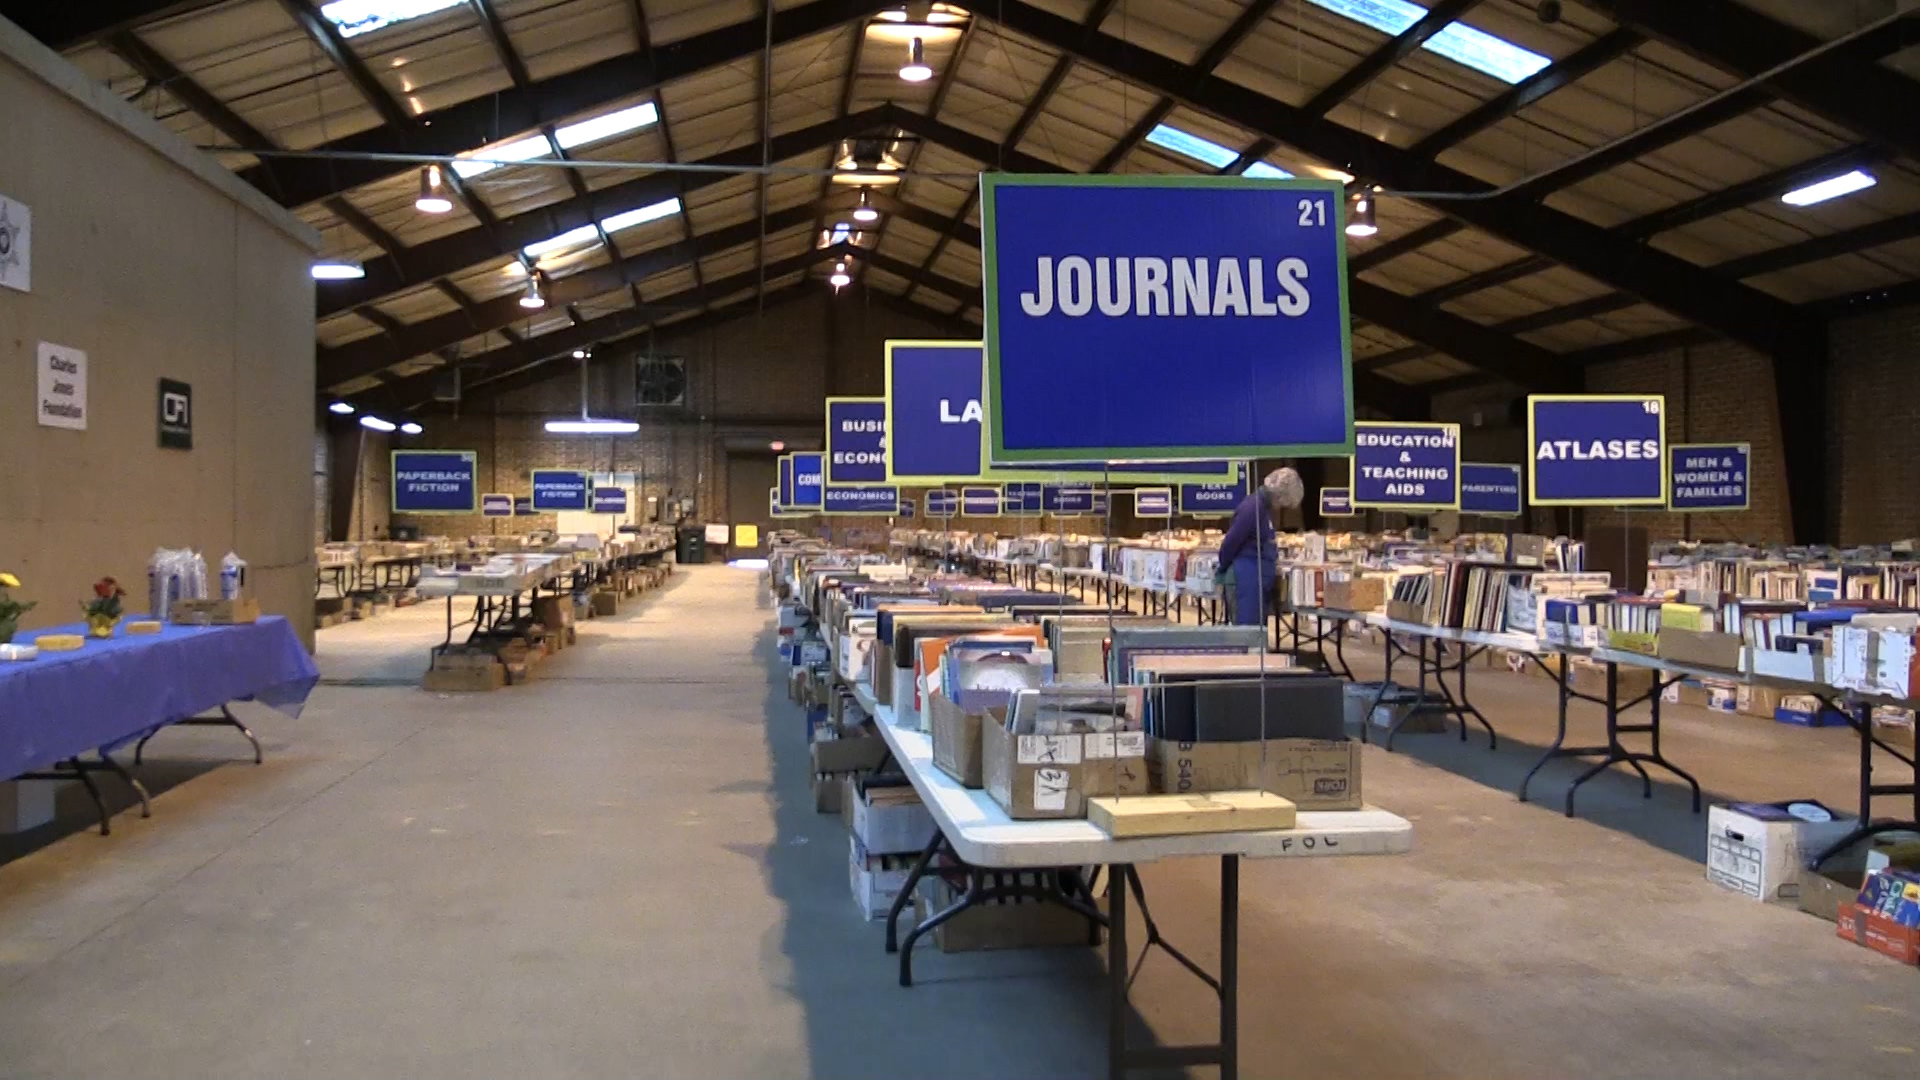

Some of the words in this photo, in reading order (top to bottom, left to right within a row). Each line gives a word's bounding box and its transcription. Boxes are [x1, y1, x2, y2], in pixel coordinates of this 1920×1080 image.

[1298, 199, 1326, 226] 21
[1020, 256, 1310, 316] JOURNALS
[940, 399, 983, 422] LA
[1642, 401, 1659, 414] 18
[842, 420, 886, 432] BUSI
[1357, 433, 1454, 448] EDUCATION
[1536, 440, 1659, 460] ATLASES
[834, 452, 886, 464] ECON
[1399, 451, 1411, 463] &
[1686, 457, 1717, 468] MEN
[1722, 456, 1732, 468] &
[397, 471, 471, 480] PAPERBACK
[798, 473, 821, 486] COM
[1362, 466, 1448, 480] TEACHING
[1674, 471, 1729, 483] WOMEN
[1733, 471, 1744, 482] &
[407, 483, 460, 492] FICTION
[1385, 483, 1425, 496] AIDS
[1676, 485, 1742, 498] FAMILIES
[826, 491, 895, 500] ECONOMICS
